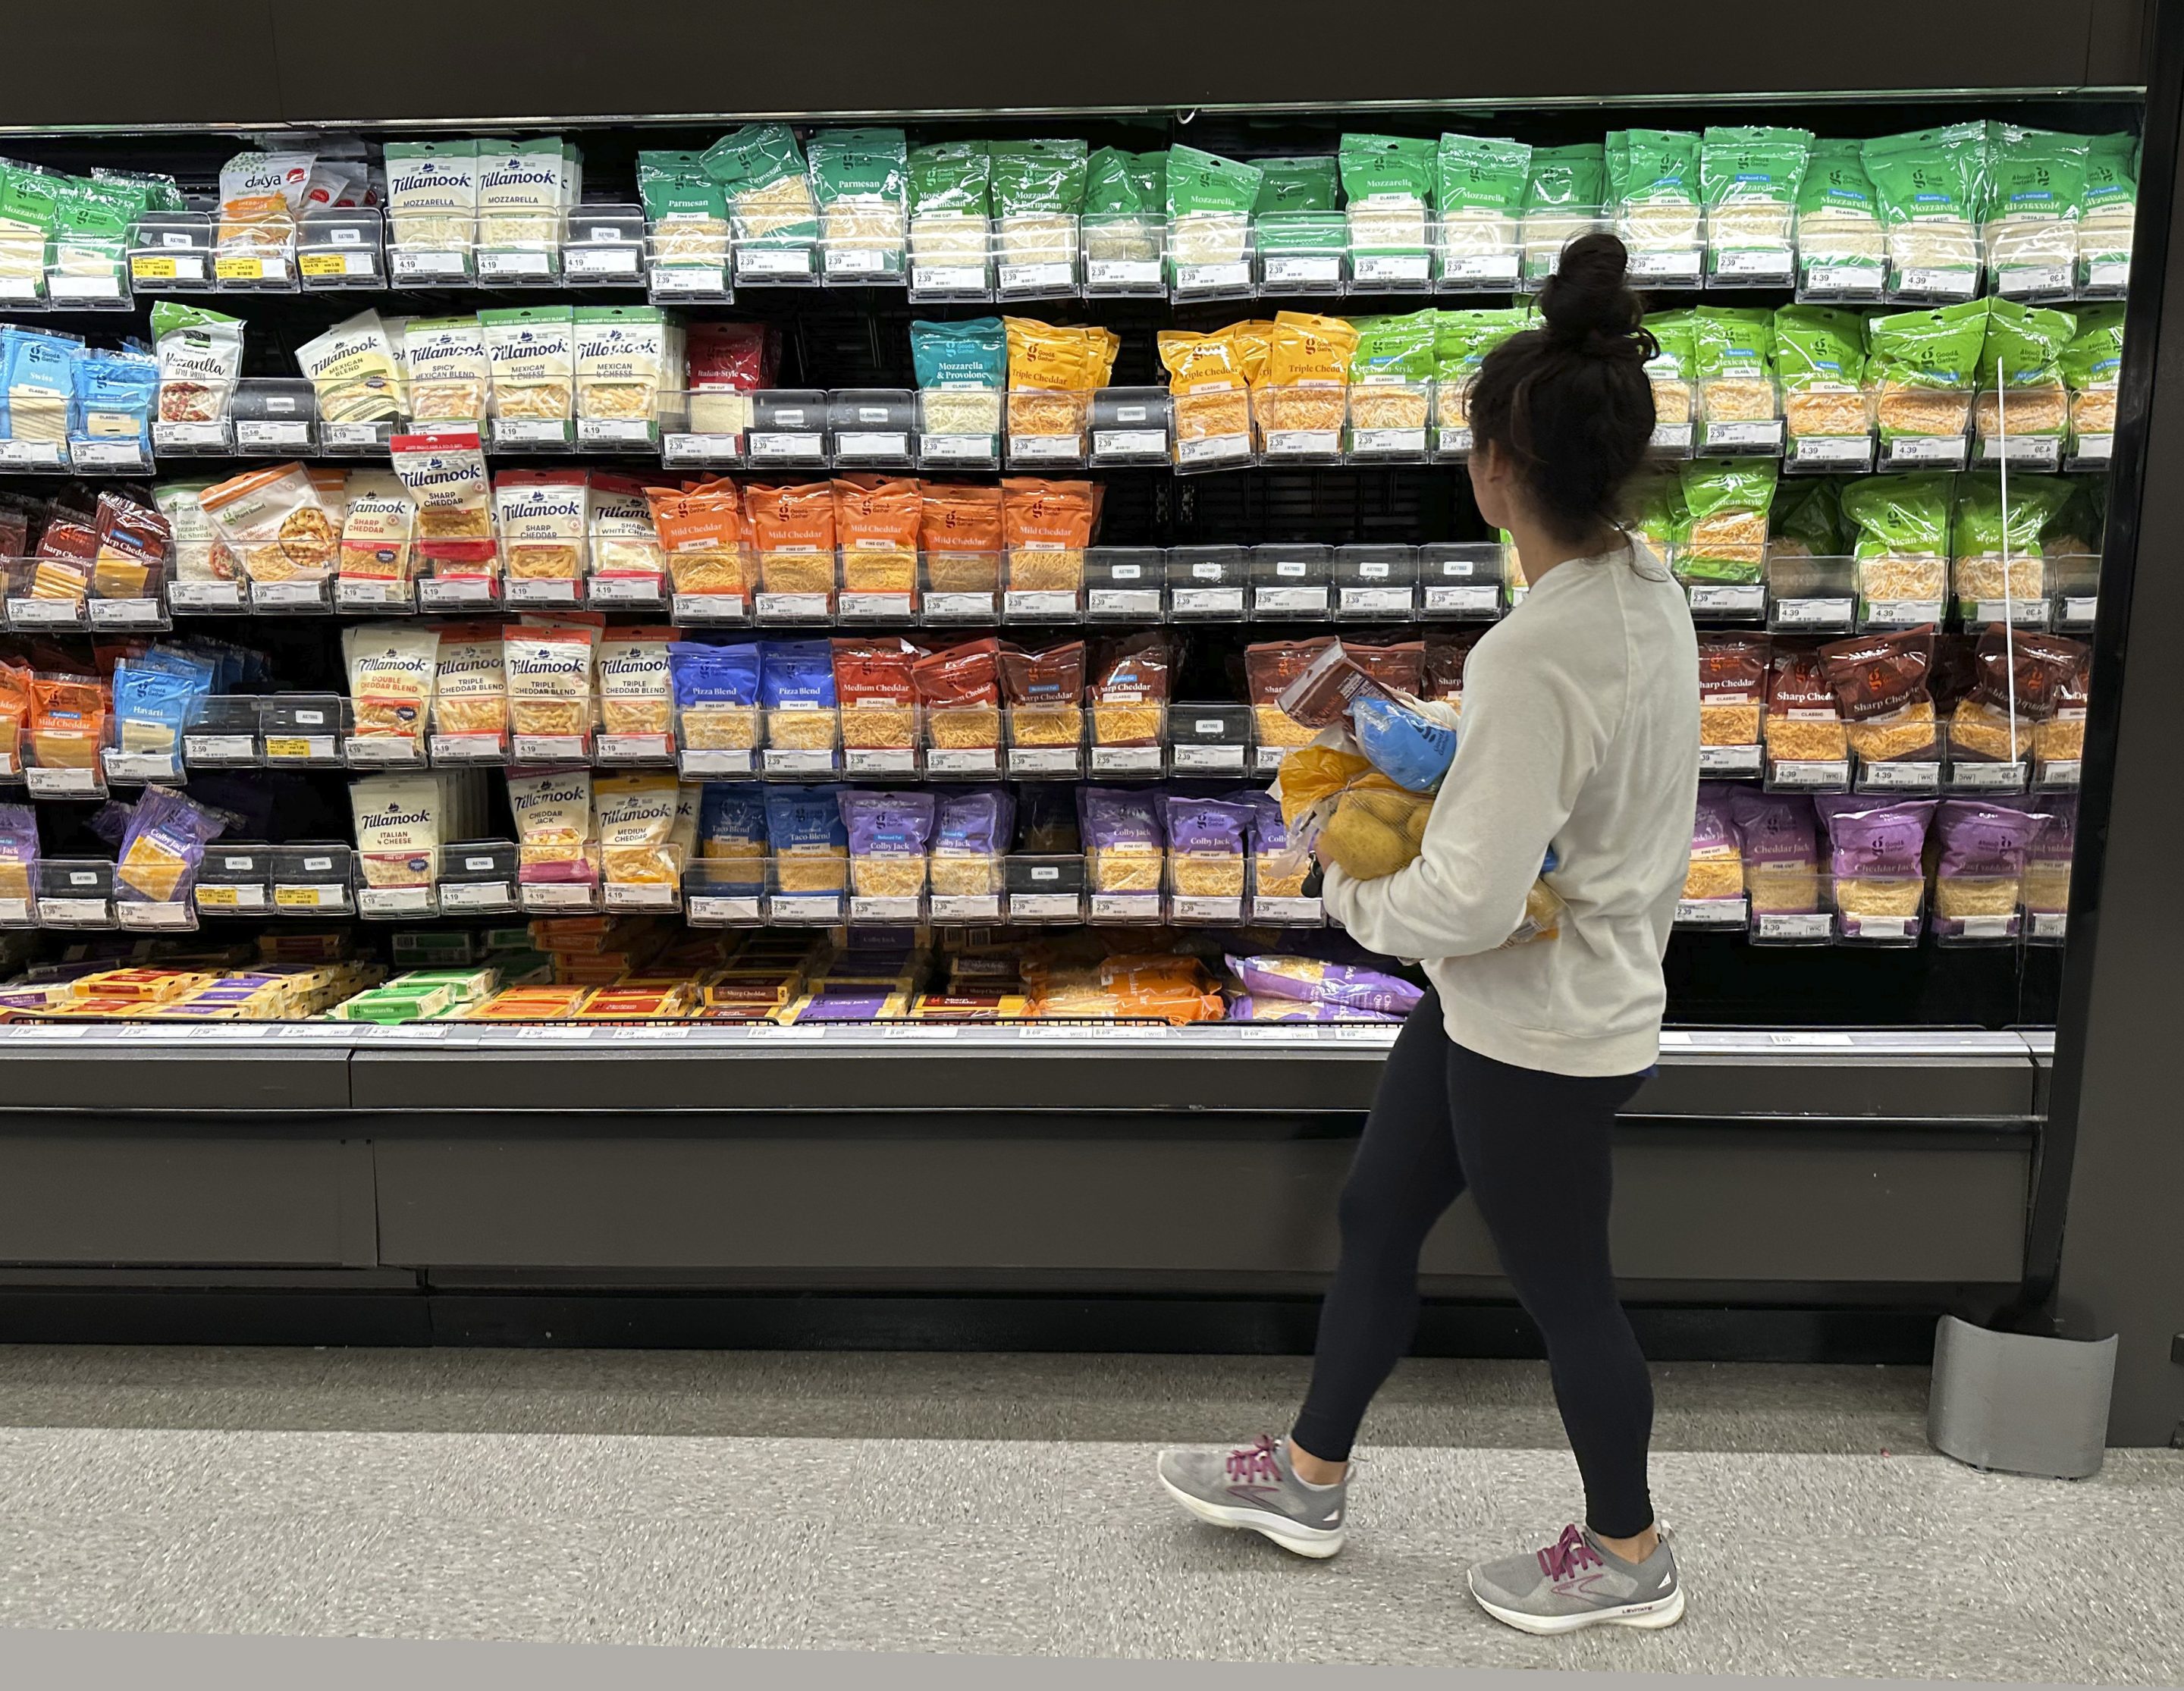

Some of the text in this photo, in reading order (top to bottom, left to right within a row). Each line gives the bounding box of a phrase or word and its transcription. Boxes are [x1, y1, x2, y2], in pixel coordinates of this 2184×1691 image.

[479, 170, 555, 190] Tillamook
[748, 166, 782, 184] Parmesan
[392, 173, 472, 194] Tillamook
[1367, 179, 1412, 188] Mozzarella
[1191, 196, 1235, 206] Mozzarella
[1462, 191, 1505, 202] Mozzarella
[668, 199, 708, 207] Parmesan
[1819, 196, 1873, 210] Mozzarella
[2, 204, 49, 222] Mozzarella
[1721, 259, 1735, 267] 2.39
[491, 339, 569, 361] Tillamook
[311, 337, 380, 375] Tillamook
[329, 357, 363, 375] MEXICAN
[335, 364, 360, 376] BLEND
[512, 363, 544, 372] MEXICAN
[597, 362, 632, 371] MEXICAN
[939, 362, 983, 370] Mozzarella
[1288, 364, 1312, 373] Triple
[946, 371, 987, 379] Provolone
[1012, 369, 1068, 386] Triple Cheddar
[400, 466, 480, 488] Tillamook
[428, 492, 456, 500] SHARP
[424, 497, 463, 507] CHEDDAR
[503, 503, 579, 522] Tillamook
[348, 525, 384, 534] CHEDDAR
[621, 522, 645, 532] SHARP
[671, 523, 723, 536] Mild Cheddar
[850, 525, 902, 534] Mild Cheddar
[1020, 526, 1072, 537] Mild Cheddar
[520, 532, 557, 540] CHEDDAR
[768, 531, 822, 539] Mild Cheddar
[934, 535, 987, 546] Mild Cheddar
[359, 657, 425, 672] Tillamook
[510, 657, 583, 675] Tillamook
[360, 682, 390, 691] CHEDDAR
[1118, 683, 1151, 692] Cheddar
[1721, 679, 1755, 688] Cheddar
[440, 685, 476, 694] CHEDDAR
[692, 687, 736, 696] Pizza Blend
[779, 687, 796, 695] Pizza
[965, 684, 991, 700] Cheddar
[1039, 692, 1073, 701] Cheddar
[1777, 692, 1803, 701] Sharp
[133, 705, 163, 717] Havarti
[1853, 700, 1880, 713] Sharp
[39, 718, 90, 729] Mild Cheddar
[515, 786, 585, 812] Tillamook
[362, 810, 431, 830] Tillamook
[529, 811, 563, 820] CHEDDAR
[601, 805, 671, 828] Tillamook
[614, 833, 648, 842] CHEDDAR
[1114, 829, 1134, 838] Colby
[151, 829, 190, 853] Colby Jack
[937, 839, 971, 848] Colby Jack
[1191, 837, 1231, 846] Colby Jack
[871, 842, 909, 851] Colby Jack
[1754, 843, 1810, 853] Cheddar Jack
